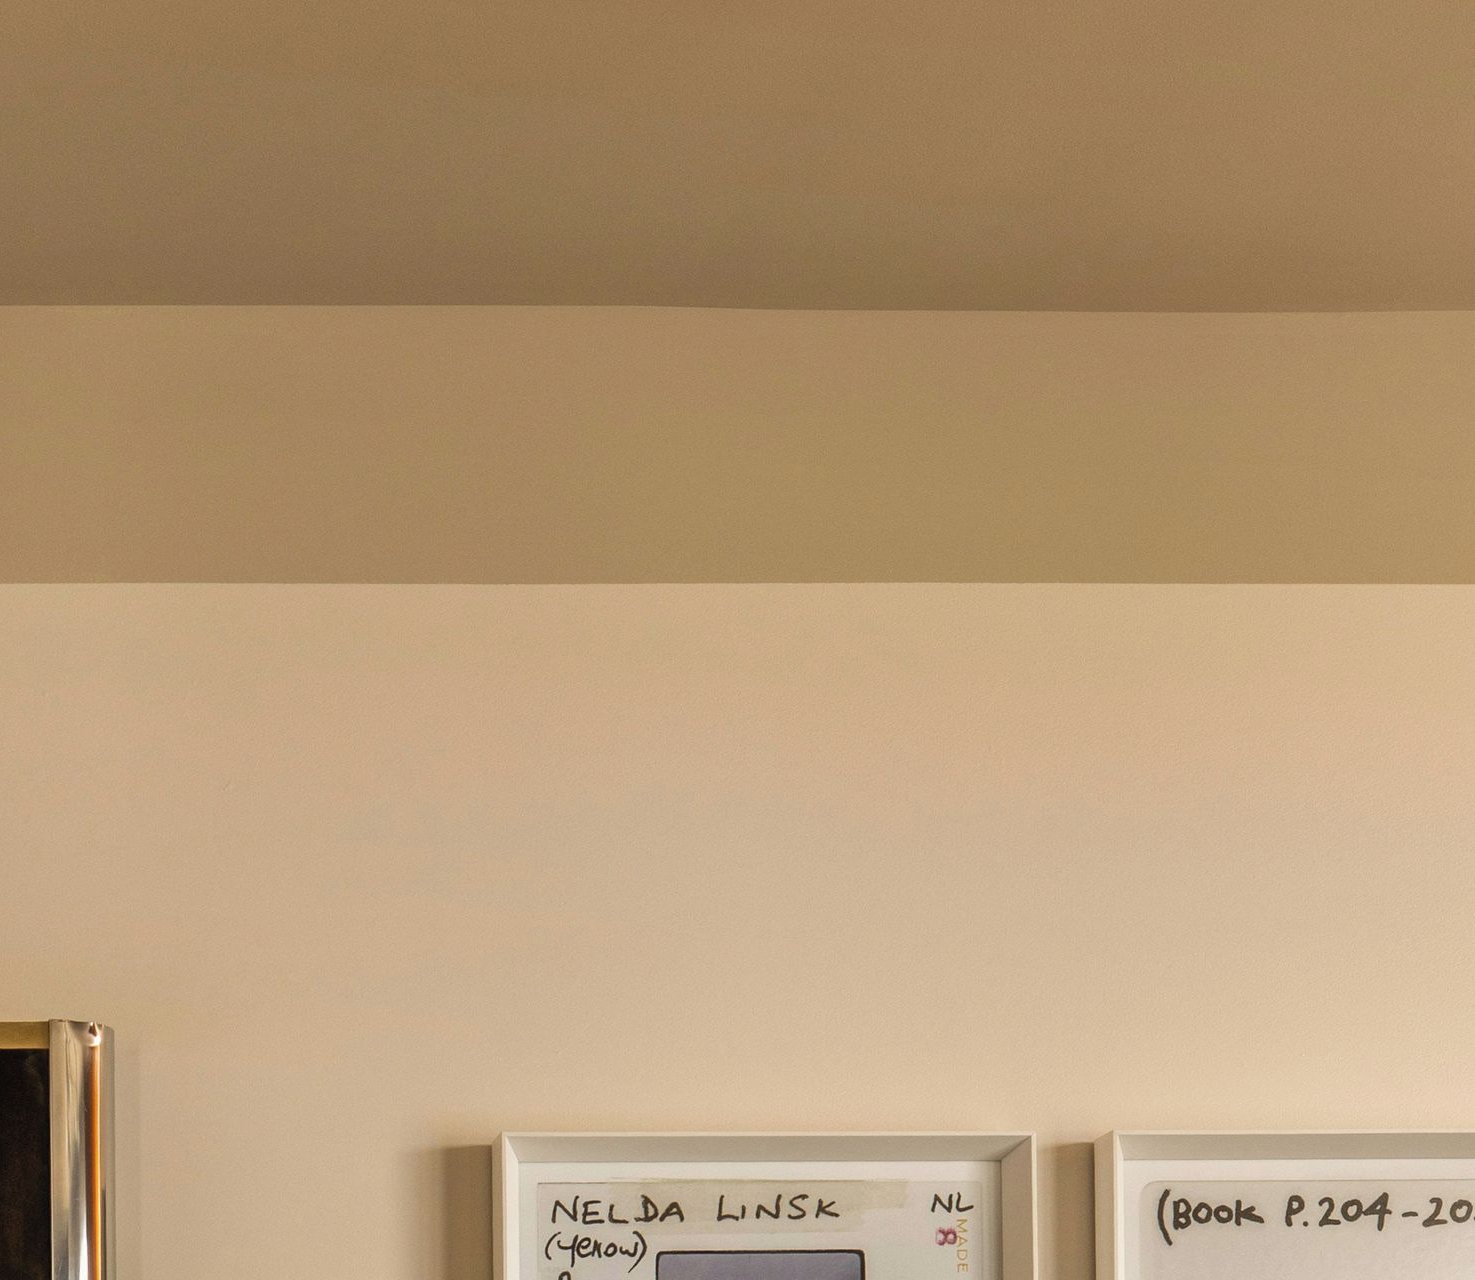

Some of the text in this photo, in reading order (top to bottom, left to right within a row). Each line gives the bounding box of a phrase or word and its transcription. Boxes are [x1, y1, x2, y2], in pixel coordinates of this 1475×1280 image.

[551, 1193, 841, 1225] NELDA LINSK
[930, 1191, 975, 1214] NL
[955, 1217, 969, 1273] MADE
